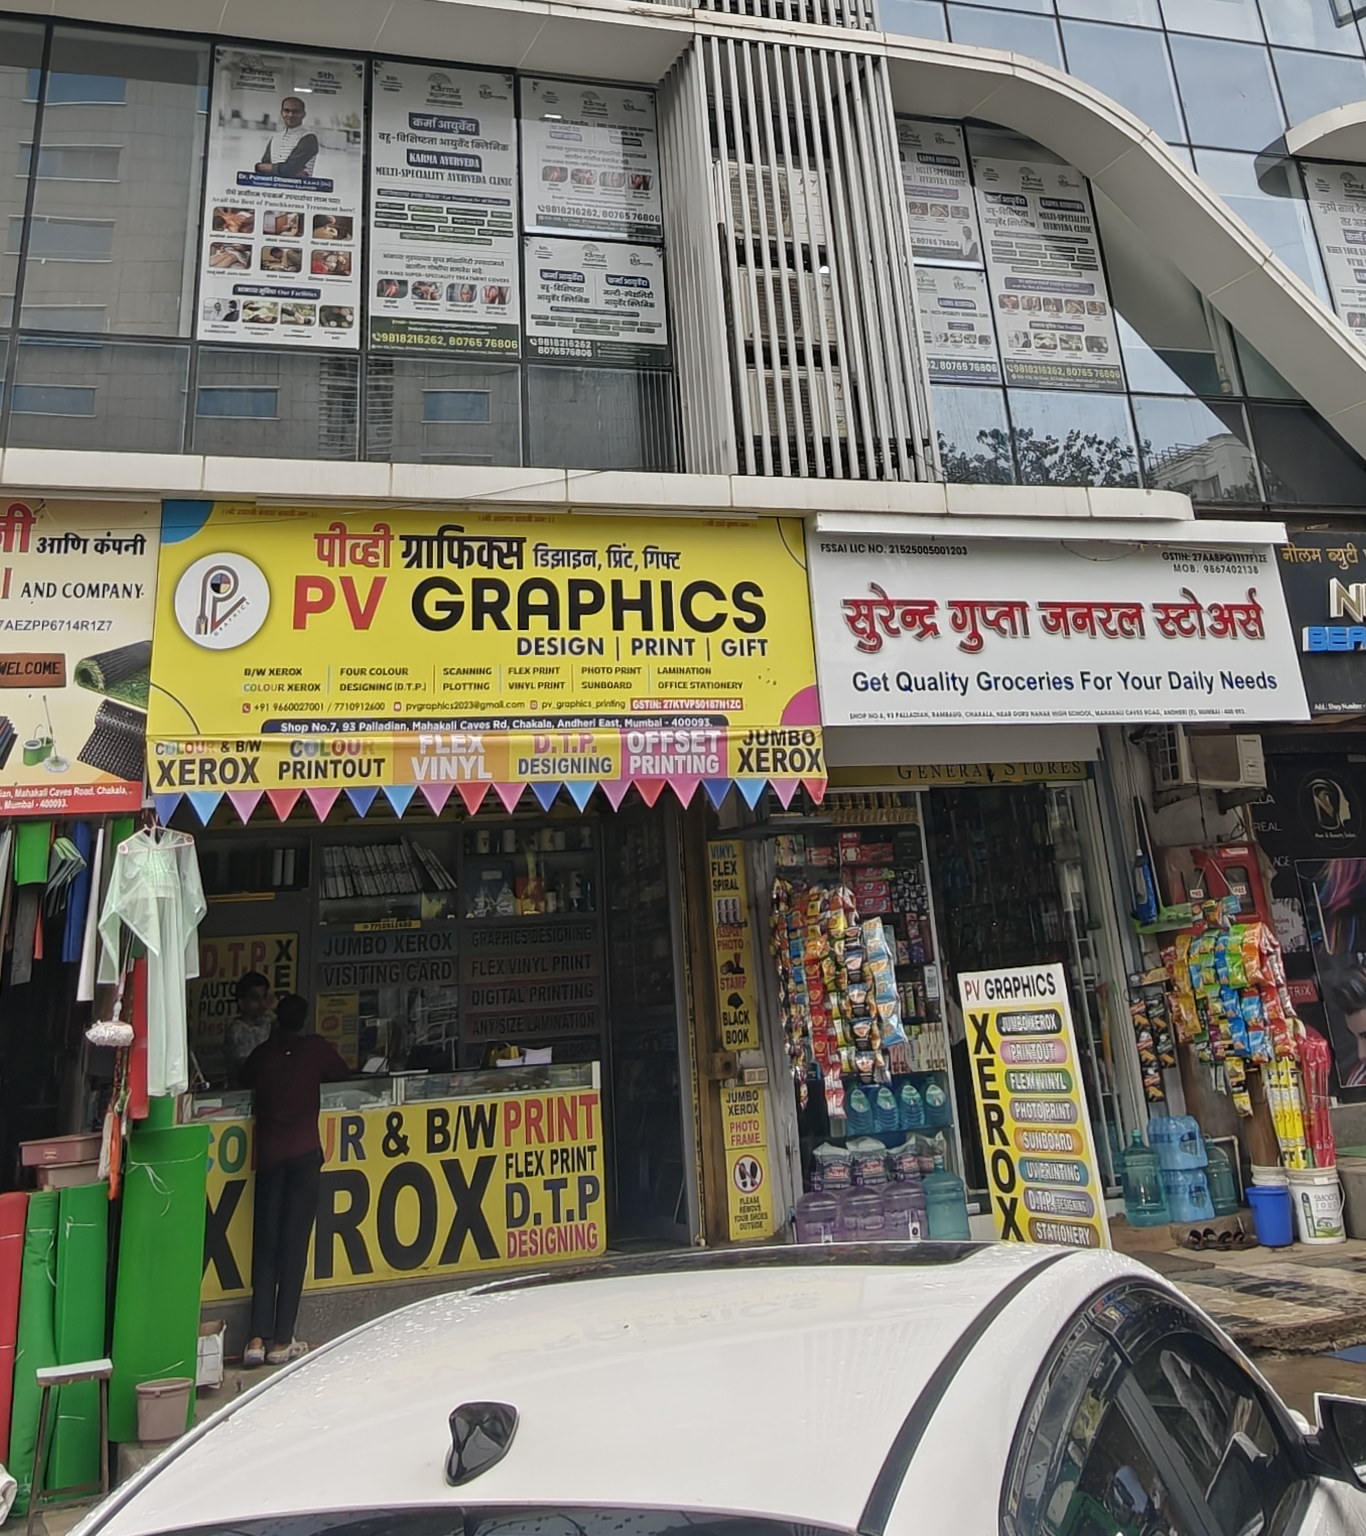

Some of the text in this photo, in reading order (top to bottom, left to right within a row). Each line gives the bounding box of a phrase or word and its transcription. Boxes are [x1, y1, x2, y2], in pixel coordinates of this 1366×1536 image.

[36, 533, 89, 556] आणि
[94, 531, 147, 556] कंपनी
[313, 521, 395, 569] पीव्ही
[399, 524, 528, 572] ग्राफिक्स
[1280, 540, 1322, 564] नीलम
[21, 581, 57, 599] AND
[62, 582, 143, 600] COMPANY
[293, 575, 768, 634] PV GRAPHICS
[841, 580, 1268, 654] सुरेन्द्र गुप्ता जनरल स्टोअर्स
[516, 636, 769, 658] DESIGN PRINT GIFT
[243, 667, 303, 677] B/W XEROX
[339, 667, 410, 677] FOUR COLOUR
[442, 666, 493, 676] SCANNING
[507, 666, 561, 676] FLEX PRINT
[581, 666, 643, 676] PHOTO PRINT
[657, 666, 712, 676] LAMINATION
[242, 682, 322, 693] COLOUR XEROX
[442, 681, 491, 692] PLOTTING
[507, 681, 566, 691] VINYL PRINT
[580, 680, 633, 691] SUNBOARD
[657, 680, 743, 691] OFFICE STATIONERY
[852, 670, 1279, 697] Get Quality Groceries For Your Daily Needs
[253, 702, 270, 712] +91
[418, 733, 486, 755] FLEX
[626, 731, 723, 754] OFFSET
[742, 729, 817, 747] JUMBO
[277, 758, 387, 781] PRINTOUT
[410, 756, 492, 781] VINYL
[517, 756, 613, 777] DESIGNING
[628, 754, 720, 776] PRINTING
[737, 747, 823, 774] XEROX
[156, 757, 261, 788] XEROX
[710, 860, 738, 878] FLEX
[322, 930, 453, 958] JUMBO XEROX
[323, 962, 403, 989] VISITING
[404, 958, 453, 984] CARD
[720, 976, 748, 991] STAMP
[470, 981, 595, 1008] DIGITAL PRINTING
[963, 972, 1057, 1002] PV GRAPHICS
[722, 1010, 751, 1027] BLACK
[725, 1089, 760, 1104] JUMBO
[727, 1102, 760, 1117] XEROX
[503, 1093, 600, 1148] PRINT
[729, 1119, 760, 1134] PHOTO
[730, 1132, 761, 1147] FRAME
[1022, 1131, 1075, 1152] SUNBOARD
[504, 1145, 598, 1180] FLEX PRINT
[506, 1221, 599, 1260] DESIGNING
